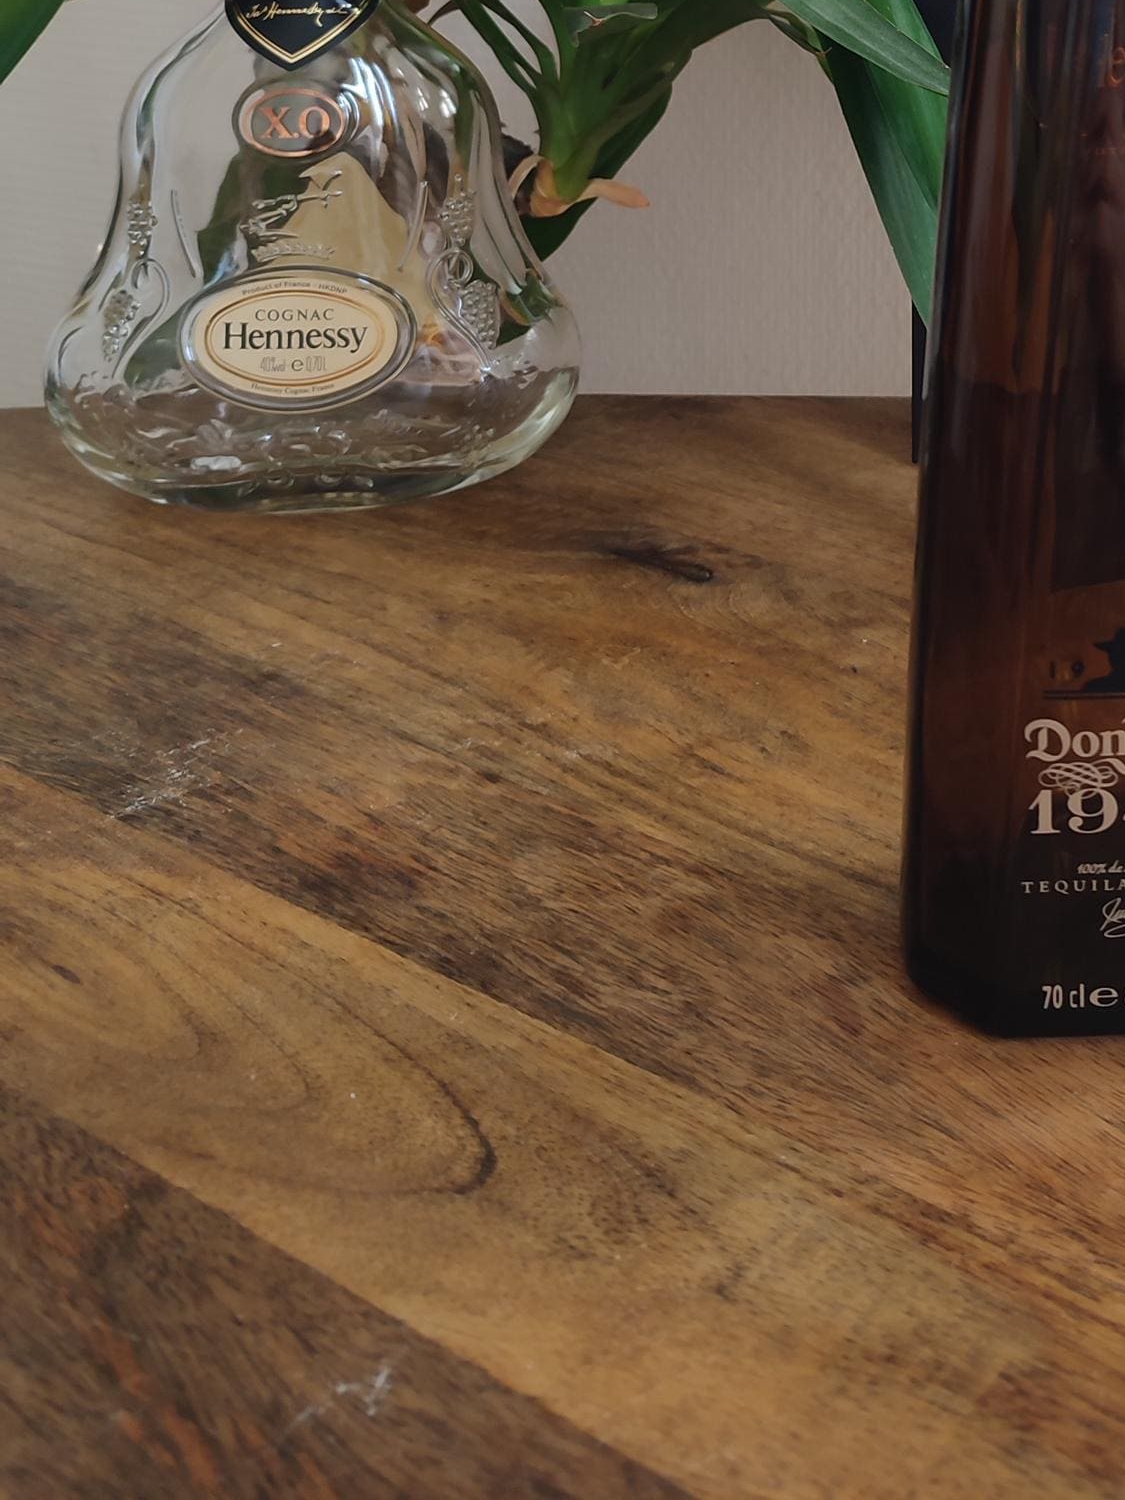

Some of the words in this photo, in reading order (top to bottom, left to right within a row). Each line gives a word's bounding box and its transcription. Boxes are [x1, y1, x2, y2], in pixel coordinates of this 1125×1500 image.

[242, 282, 273, 296] Product
[283, 280, 312, 288] France
[254, 308, 335, 322] COGNAC
[223, 321, 369, 354] Hennessy
[1041, 984, 1063, 1011] 70
[1069, 982, 1085, 1009] cl
